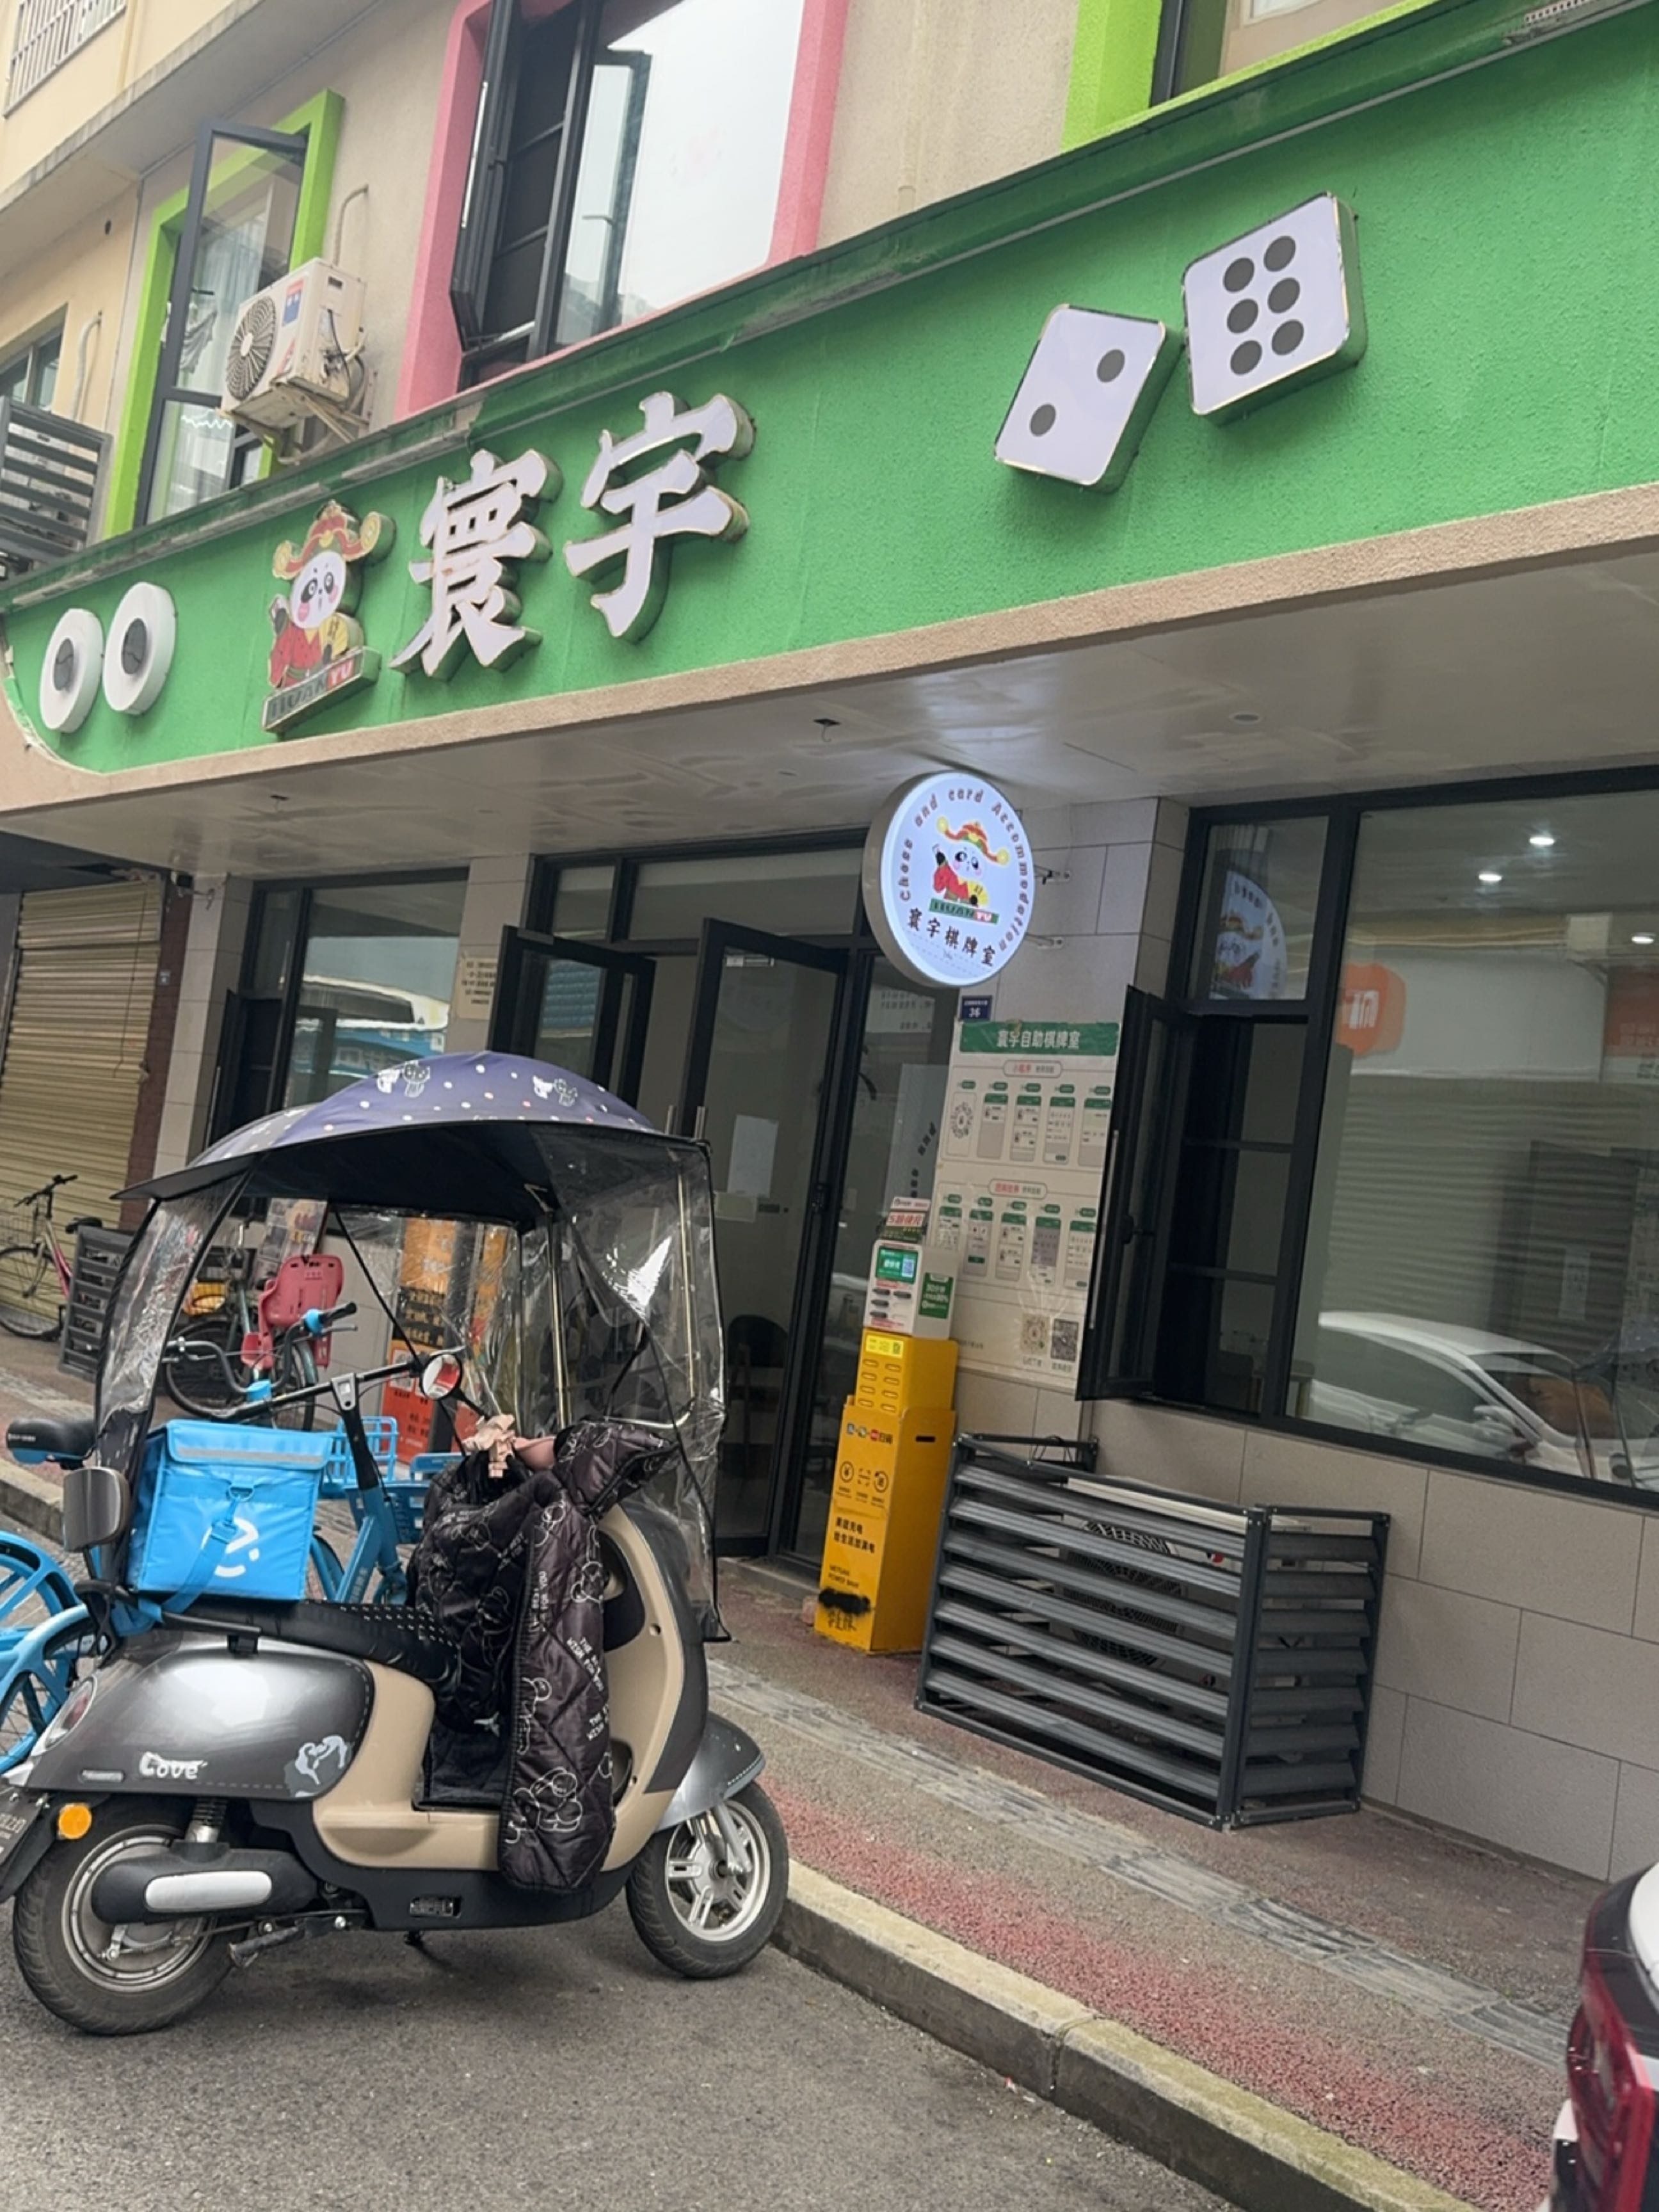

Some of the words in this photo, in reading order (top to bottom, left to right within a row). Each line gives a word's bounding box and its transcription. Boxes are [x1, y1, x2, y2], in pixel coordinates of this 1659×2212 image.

[389, 391, 739, 677] 寰宇
[915, 793, 938, 827] and
[948, 788, 984, 804] card
